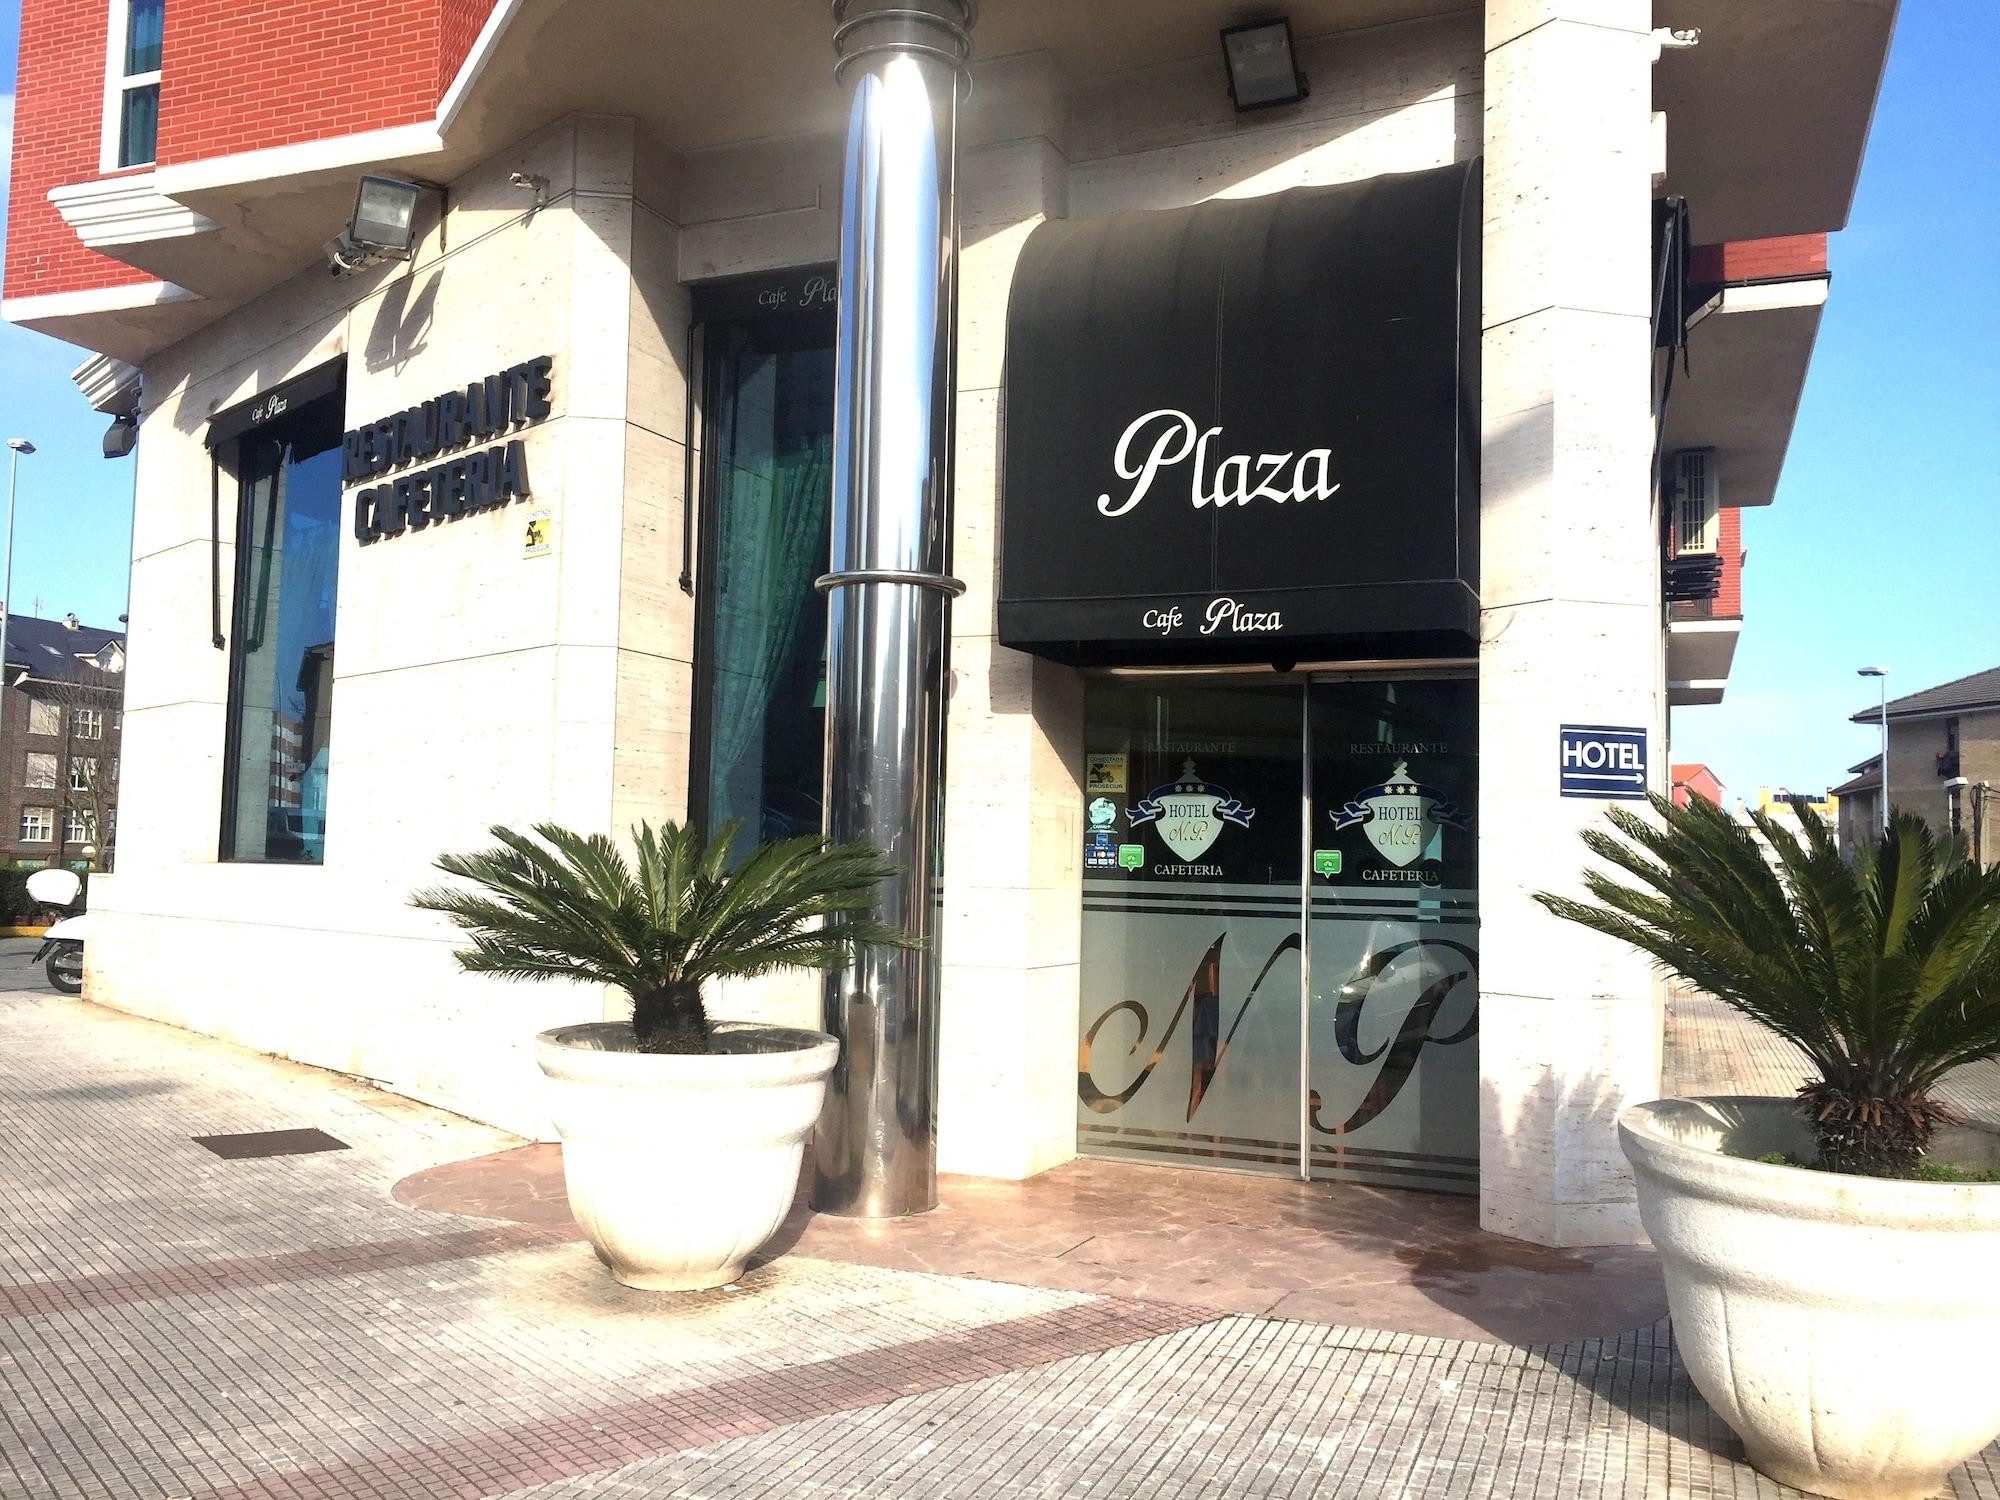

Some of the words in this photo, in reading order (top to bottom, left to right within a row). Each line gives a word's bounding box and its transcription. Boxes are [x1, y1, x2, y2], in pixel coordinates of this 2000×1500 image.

[759, 286, 787, 310] Cafe
[342, 356, 553, 486] RESTAURANTE
[1097, 409, 1341, 517] Plaza
[355, 440, 531, 547] CAFETERIA
[1143, 606, 1184, 636] Cafe
[1200, 598, 1284, 635] Plaza
[1148, 742, 1236, 753] RESTAURANTE
[1350, 743, 1448, 754] RESTAURANTE
[1563, 740, 1645, 770] HOTEL
[1169, 804, 1209, 818] HOTEL
[1378, 806, 1423, 821] HOTEL
[1154, 864, 1223, 876] CAFETERIA
[1362, 869, 1439, 881] CAFETERIA
